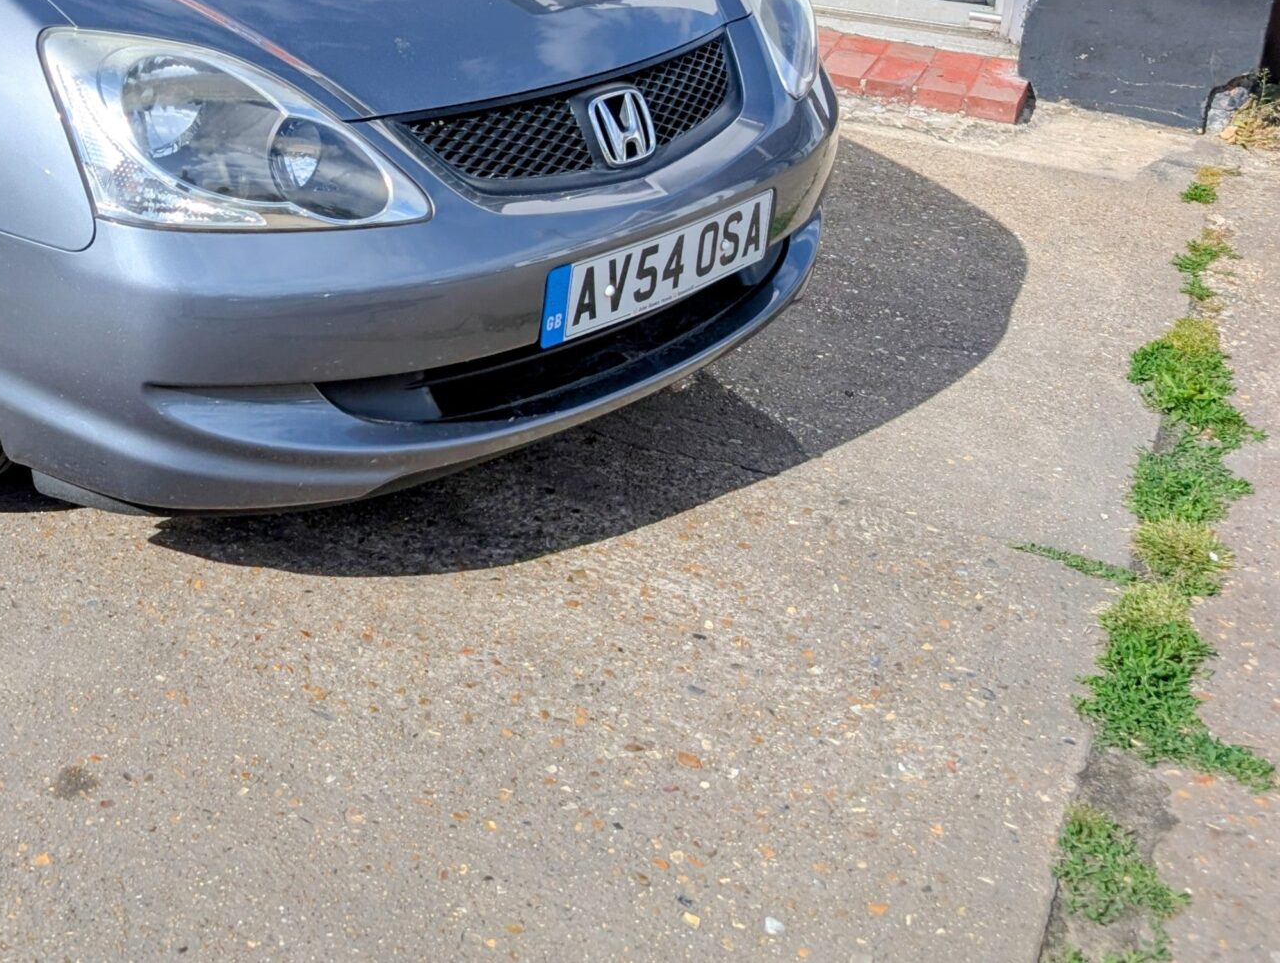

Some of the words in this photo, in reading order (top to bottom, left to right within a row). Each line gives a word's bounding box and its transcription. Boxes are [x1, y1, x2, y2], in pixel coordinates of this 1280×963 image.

[572, 234, 685, 326] AV54
[695, 201, 762, 278] OSA
[546, 312, 562, 331] GB
